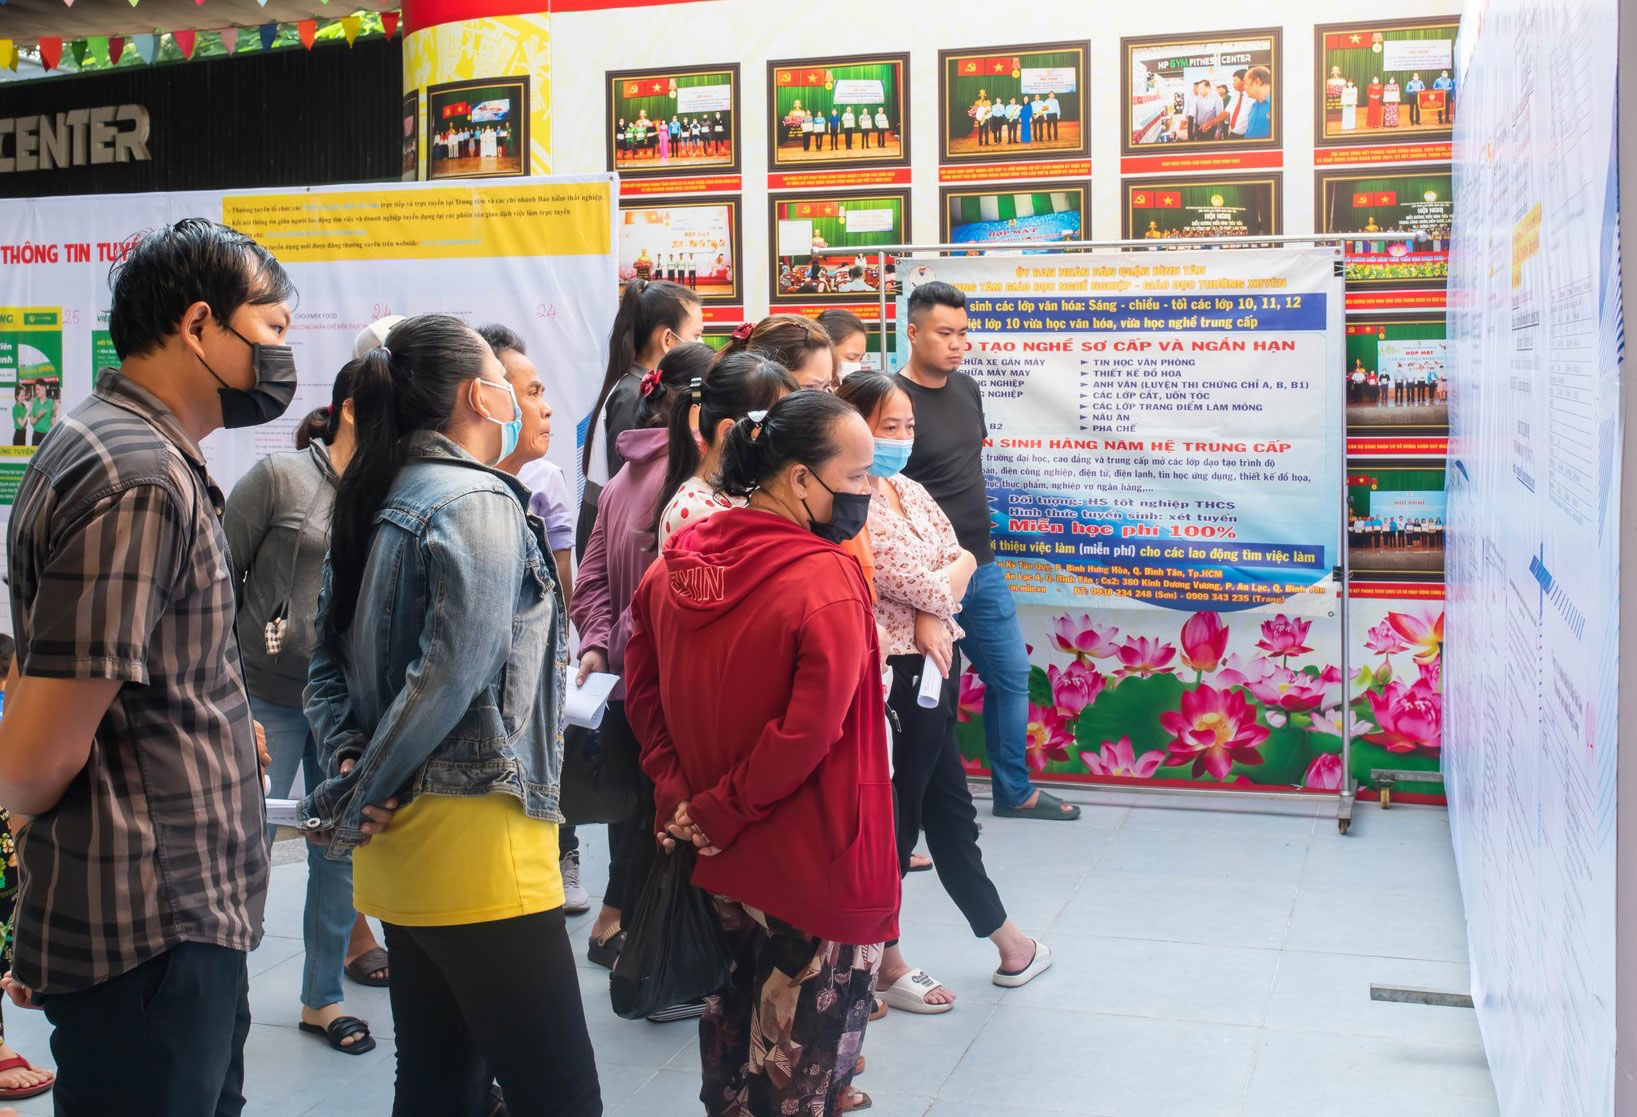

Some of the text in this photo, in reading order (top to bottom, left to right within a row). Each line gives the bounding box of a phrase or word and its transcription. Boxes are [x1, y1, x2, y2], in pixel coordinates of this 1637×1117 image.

[1158, 61, 1169, 70] HP
[1170, 59, 1189, 68] GYM
[1221, 54, 1252, 63] CENTER
[1, 240, 59, 265] THÔNG
[65, 243, 91, 263] TIN
[536, 304, 556, 319] 24
[969, 301, 992, 312] sinh
[995, 301, 1015, 312] các
[1018, 300, 1035, 313] lớp
[1038, 301, 1058, 311] văn
[1061, 300, 1085, 311] hóa:
[1088, 299, 1117, 312] Sáng
[1129, 297, 1160, 310] chiều
[1191, 299, 1211, 310] các
[1215, 298, 1234, 312] lớp
[1238, 298, 1257, 311] 10,
[1262, 297, 1281, 311] 11,
[1285, 296, 1301, 309] 12
[62, 309, 80, 325] 25
[967, 315, 1258, 332] iệt lớp 10 vừa học văn hóa, vừa học nghề trung cấp
[978, 341, 1016, 354] TẠO
[1023, 337, 1074, 352] NGHỀ
[1081, 340, 1108, 352] SƠ
[1113, 337, 1152, 351] CẤP
[1158, 339, 1184, 351] VÀ
[1191, 336, 1245, 351] NGẮN
[1253, 341, 1295, 354] HẠN
[1113, 359, 1134, 367] HỌC
[1161, 357, 1195, 366] PHÒNG
[1010, 369, 1031, 377] MAY
[1162, 370, 1182, 379] HOẠ
[990, 379, 1025, 388] NGHIỆP
[988, 389, 1024, 399] NGHIỆP
[1140, 403, 1173, 411] TRANG
[1000, 437, 1292, 453] SINH HÀNG NĂM HỆ TRUNG CẤP
[1009, 495, 1236, 510] Đối tượng: HS tốt nghiệp THCS
[1009, 507, 1238, 523] Hình thức tuyển sinh: xét tuyển
[1009, 517, 1237, 539] Miễn học phí 100%
[1000, 541, 1315, 564] thiệu việc làm (miễn phí) cho các lao động tìm việc làm
[1091, 587, 1113, 597] 0938
[1116, 589, 1133, 597] 234
[1135, 589, 1153, 598] 248
[1186, 592, 1209, 600] 0909
[1212, 593, 1229, 601] 343
[1232, 594, 1250, 602] 235
